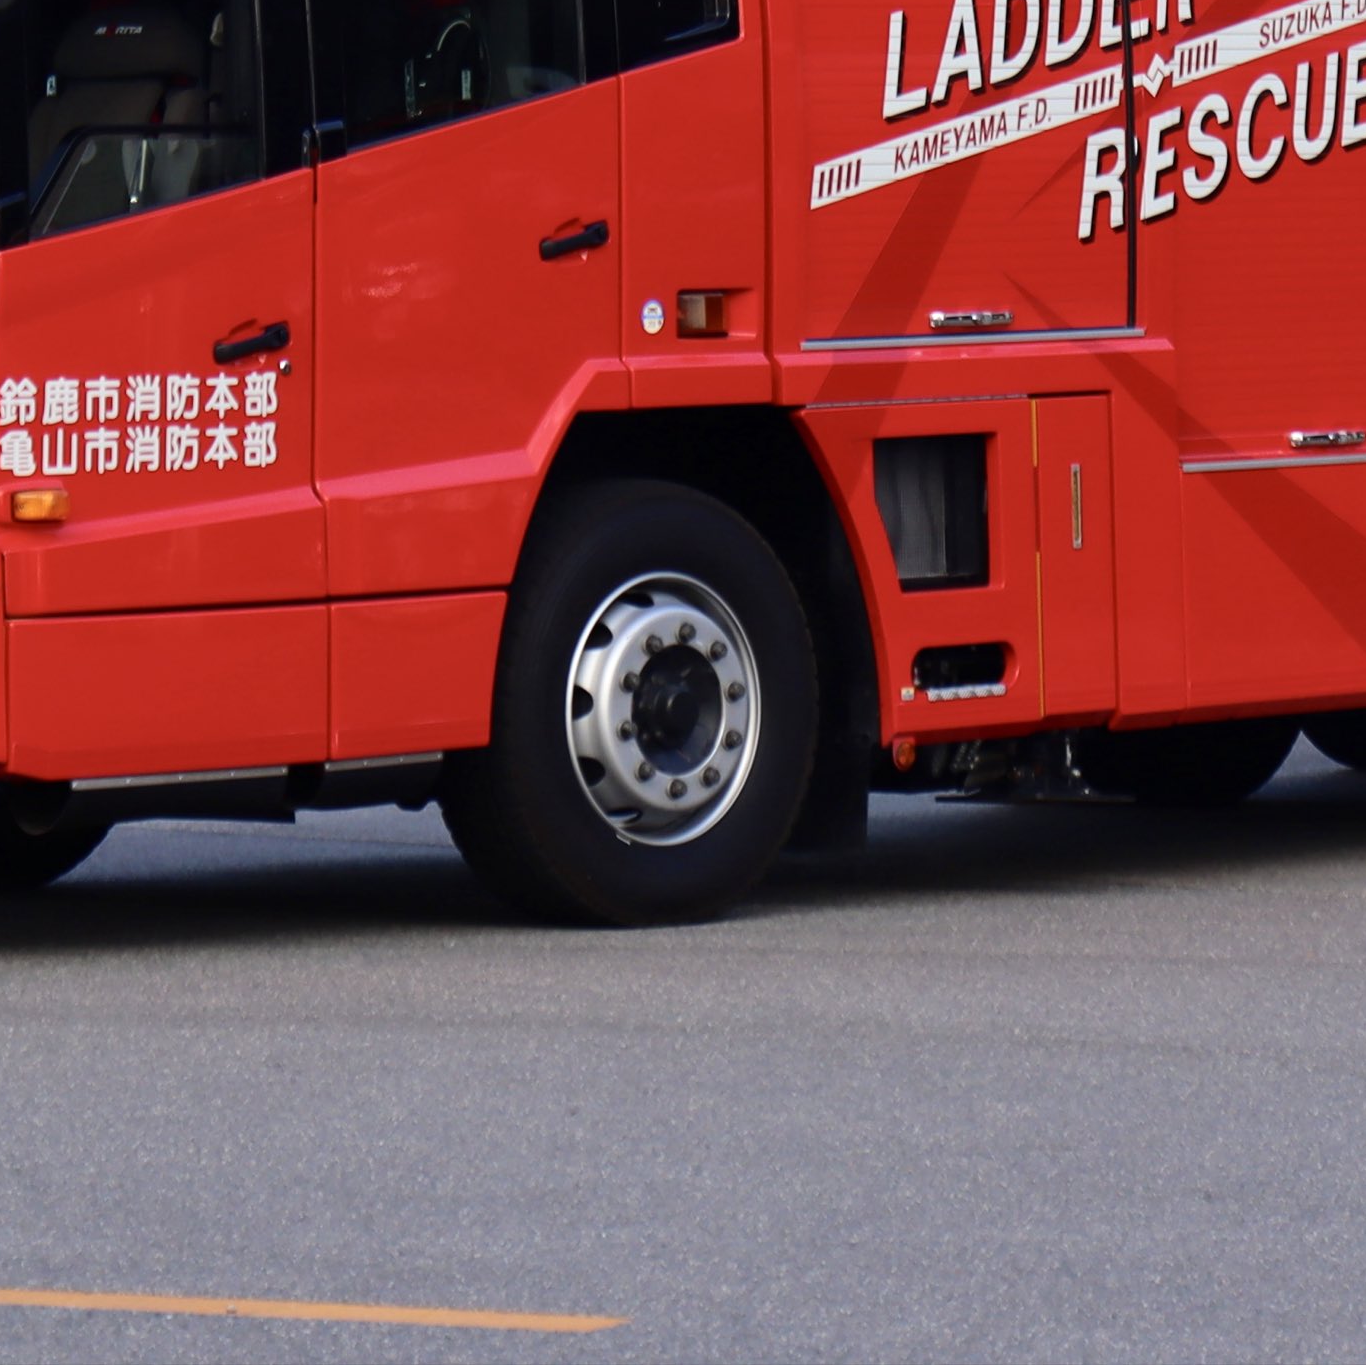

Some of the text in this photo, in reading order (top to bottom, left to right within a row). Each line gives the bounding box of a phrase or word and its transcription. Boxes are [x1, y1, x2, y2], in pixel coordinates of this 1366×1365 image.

[1259, 0, 1333, 48] SUZUKA
[894, 98, 1052, 174] KAMEYAMA F.D.
